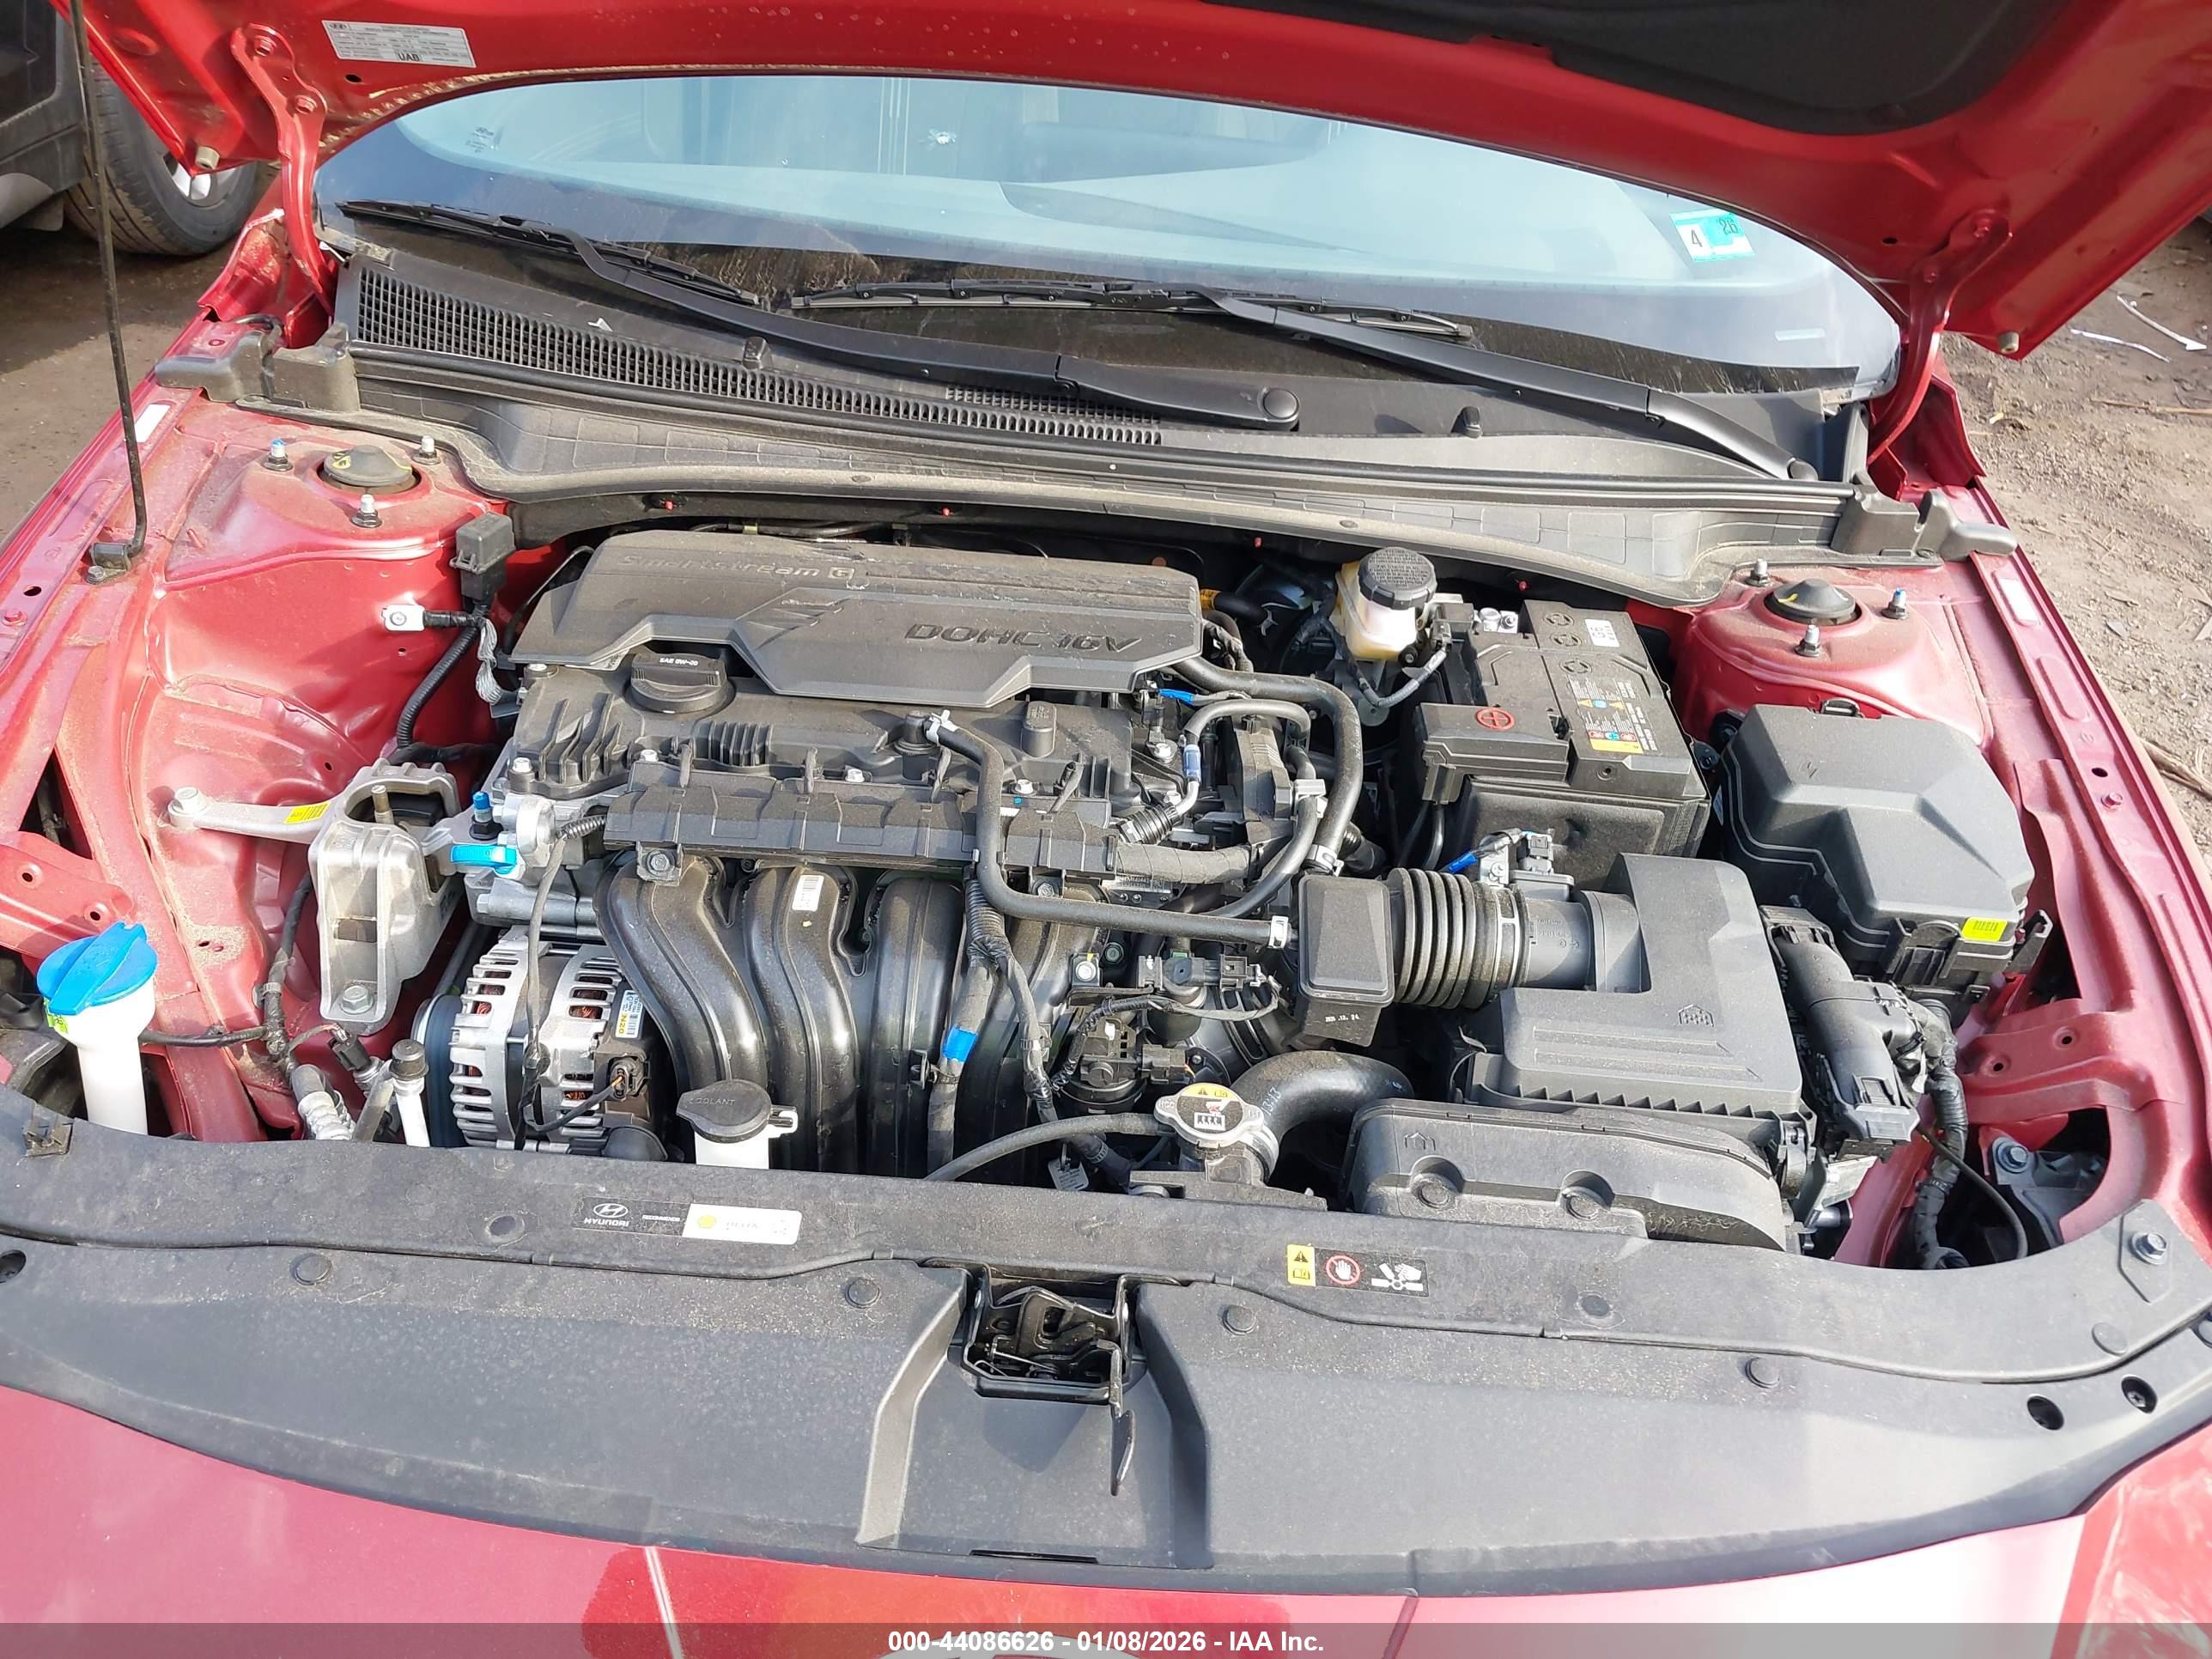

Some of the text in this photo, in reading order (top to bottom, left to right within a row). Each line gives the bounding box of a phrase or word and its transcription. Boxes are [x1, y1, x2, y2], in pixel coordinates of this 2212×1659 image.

[398, 52, 421, 62] UAB
[1691, 229, 1703, 247] 4
[619, 555, 820, 576] Smartstream
[904, 623, 1143, 653] DOHC 16V
[584, 1217, 629, 1227] HYUNDAI
